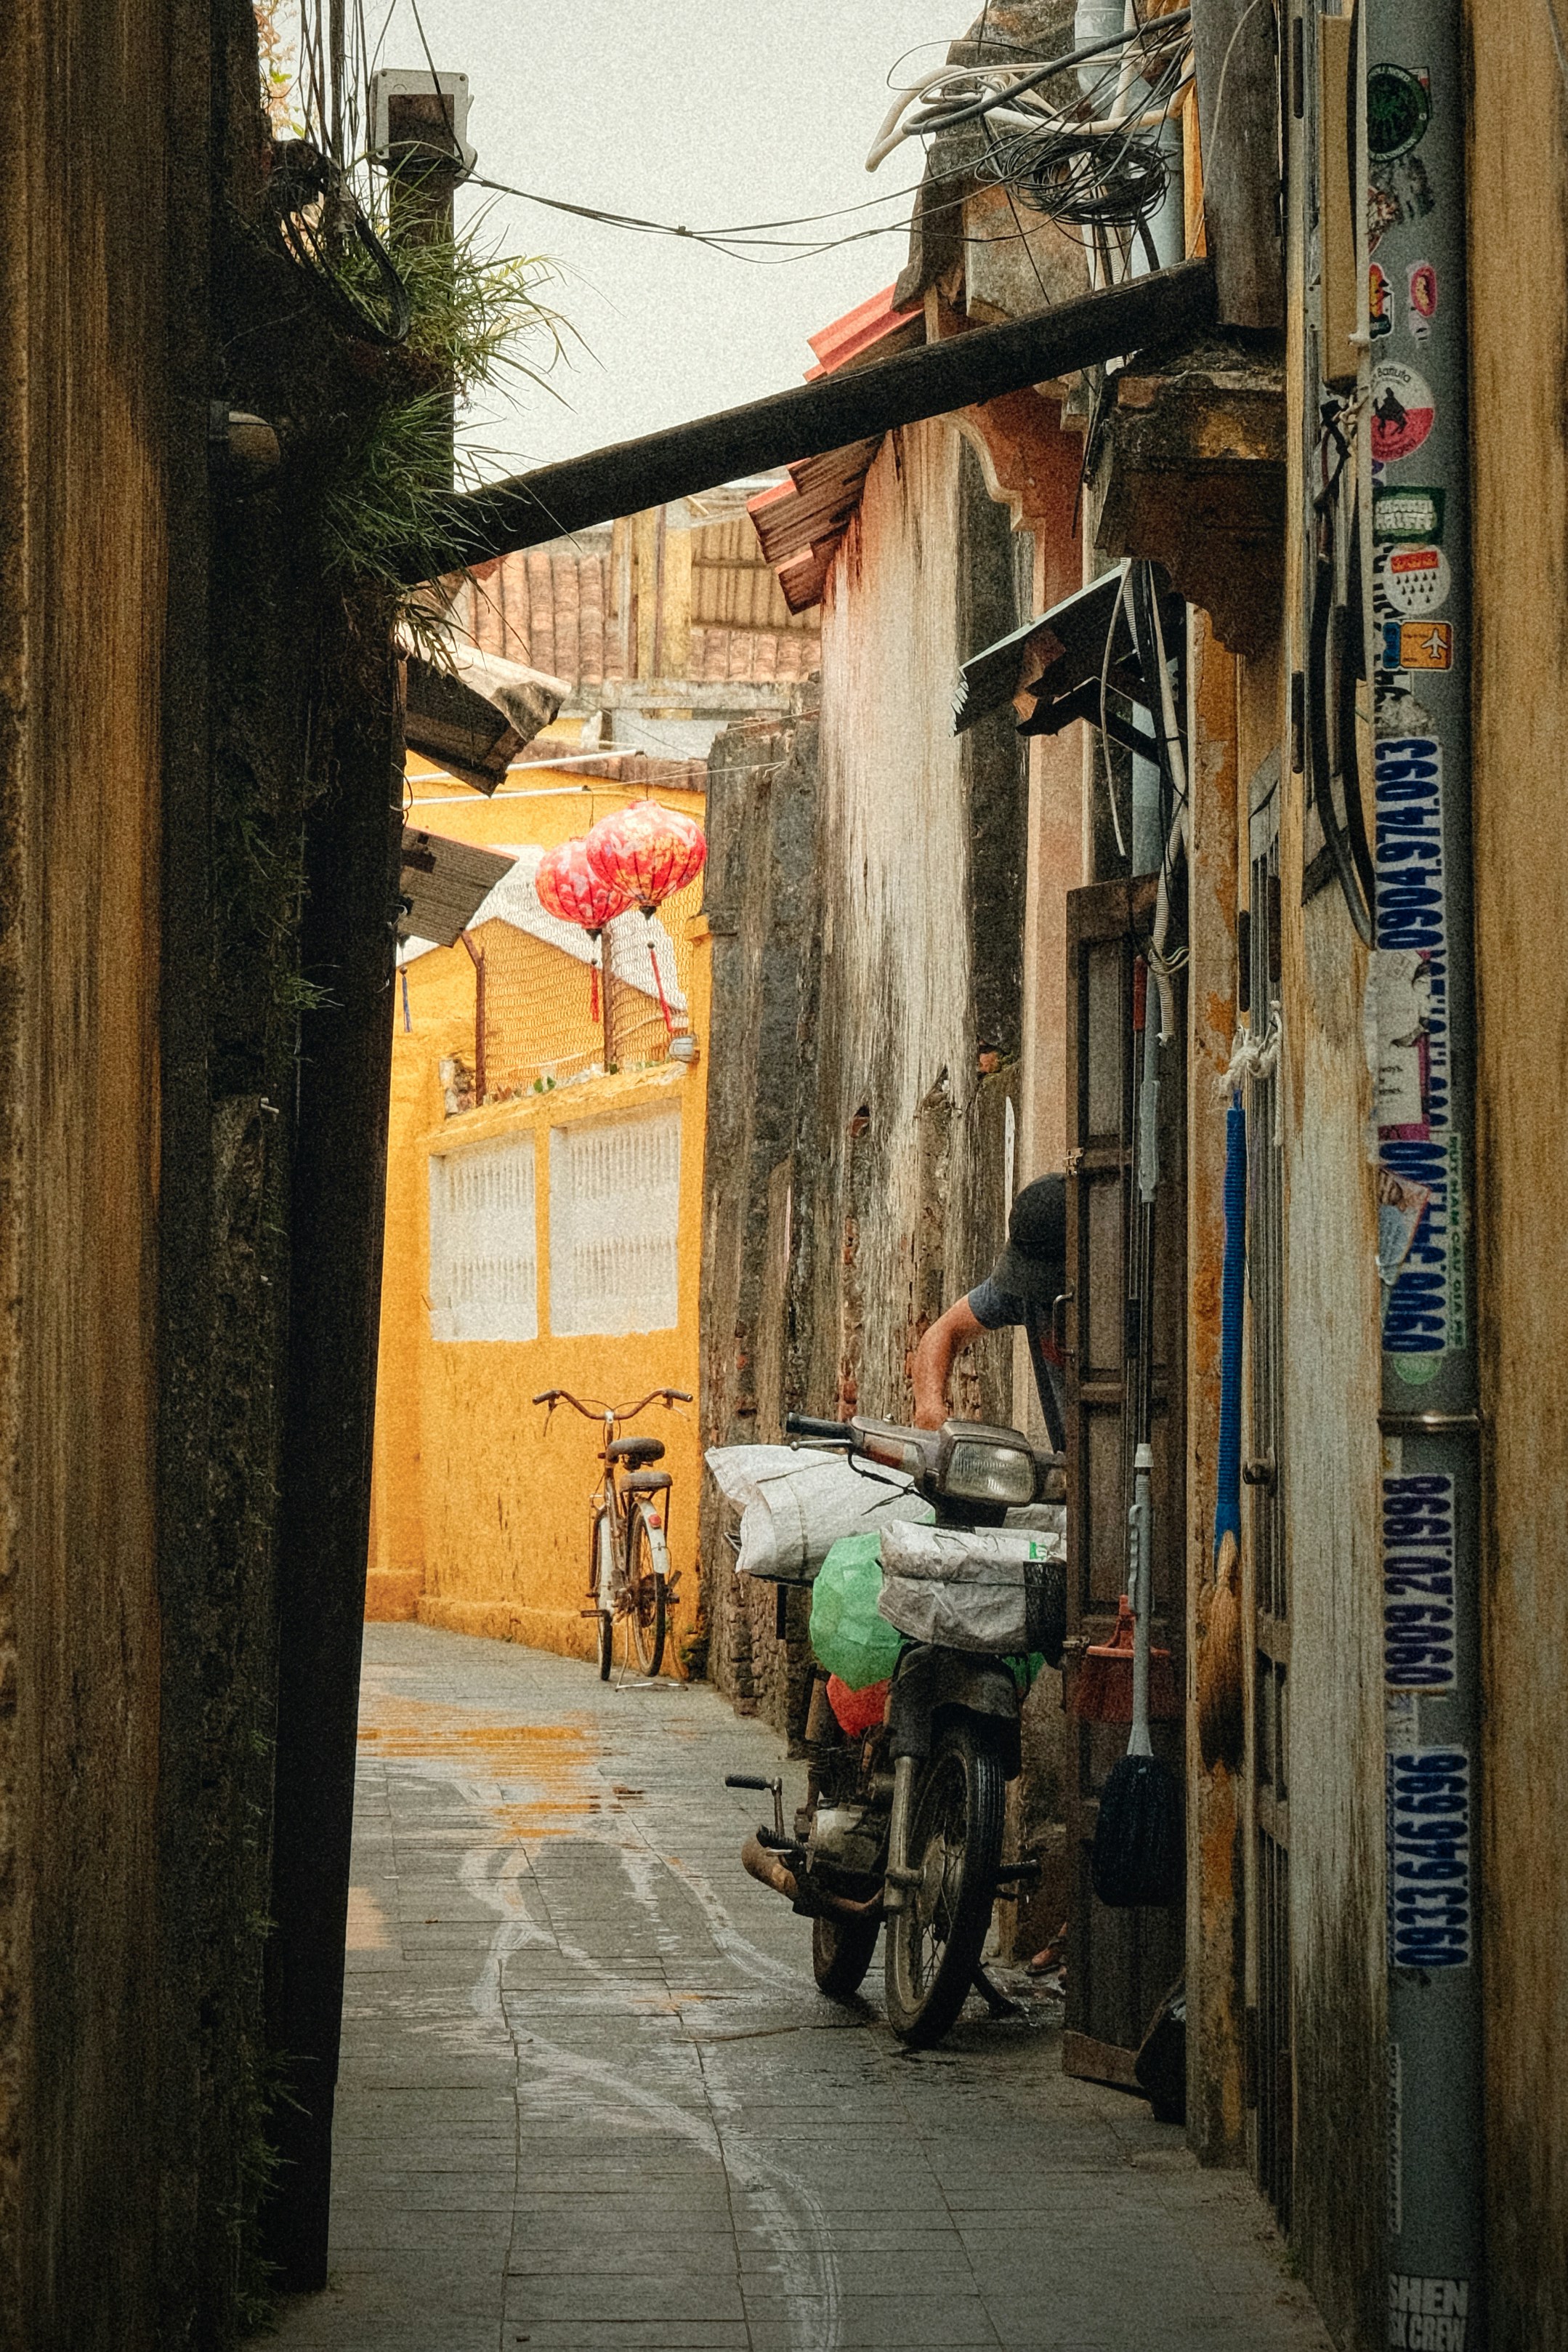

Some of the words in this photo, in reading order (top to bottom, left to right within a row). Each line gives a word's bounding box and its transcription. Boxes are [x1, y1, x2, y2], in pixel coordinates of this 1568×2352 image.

[1374, 739, 1443, 950] 0904.974.093
[1382, 1475, 1453, 1685] 0909.20.1998
[1394, 1754, 1468, 1967] 0933.646.696
